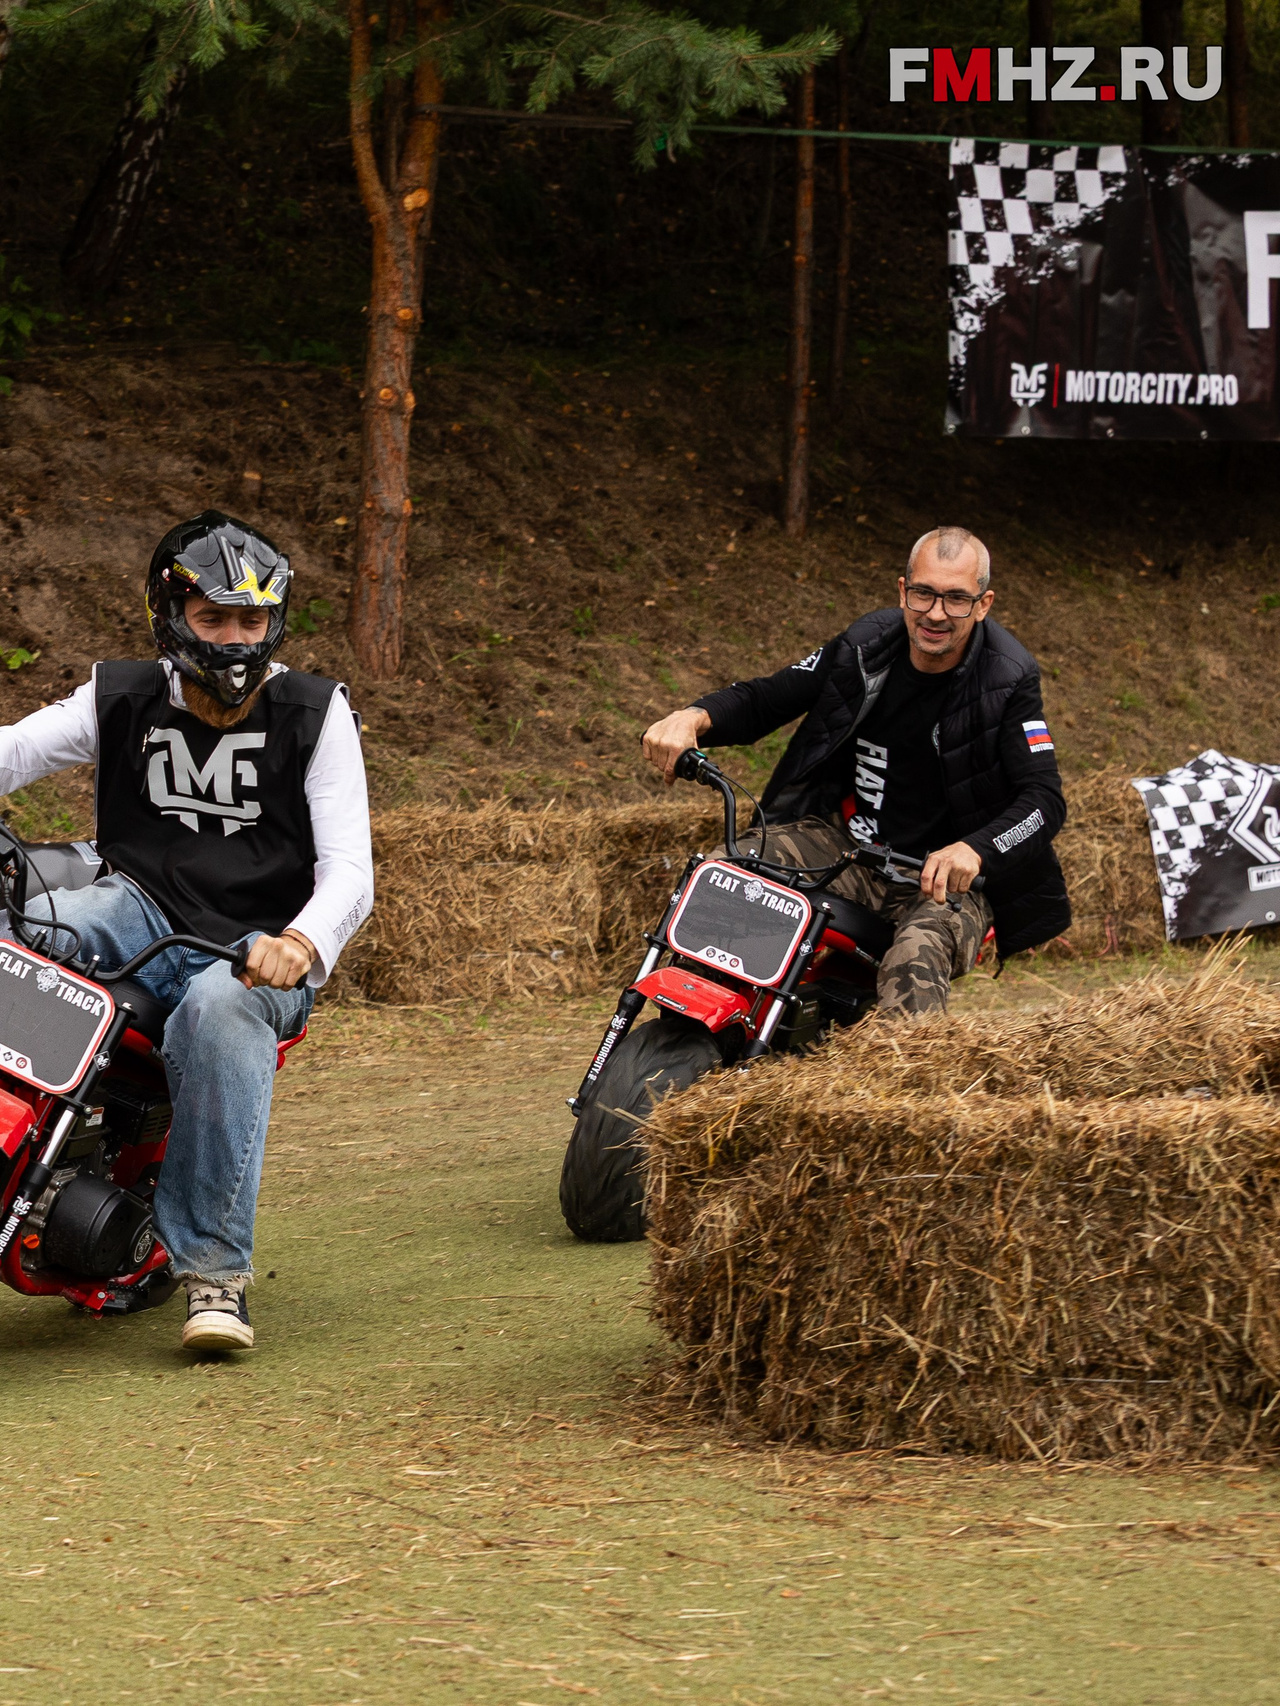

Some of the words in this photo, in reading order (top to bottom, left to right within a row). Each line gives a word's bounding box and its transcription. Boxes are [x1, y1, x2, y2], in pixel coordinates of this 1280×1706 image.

[1066, 370, 1239, 406] MOTORCITY.PRO
[855, 738, 888, 811] FLAT
[708, 870, 741, 893] FLAT
[761, 891, 803, 920] TRACK
[55, 981, 105, 1017] TRACK
